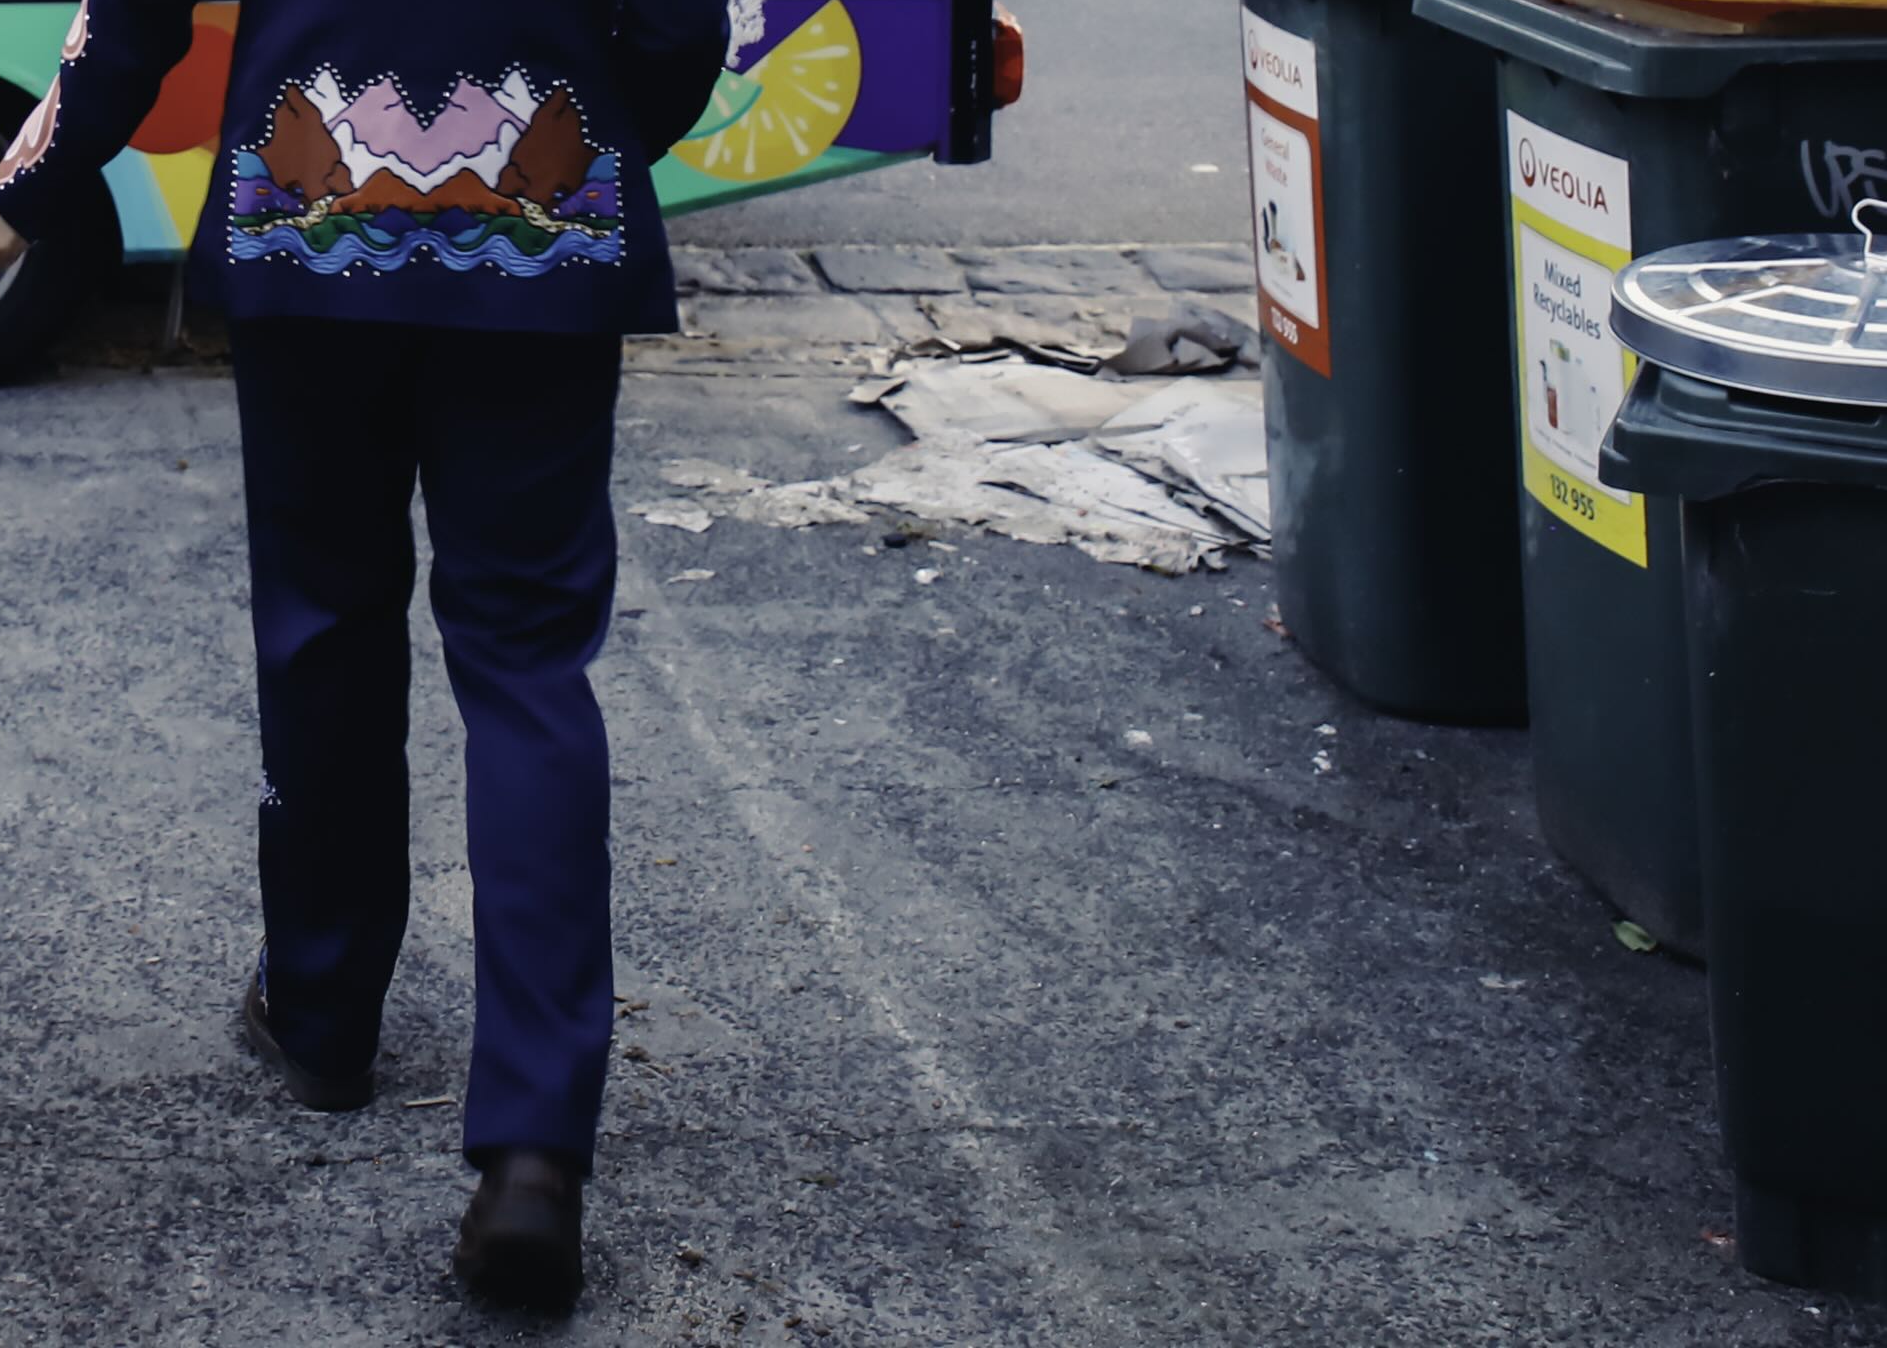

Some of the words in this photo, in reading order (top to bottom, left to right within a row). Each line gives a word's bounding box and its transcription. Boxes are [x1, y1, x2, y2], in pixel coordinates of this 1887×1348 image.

[1258, 50, 1303, 90] VEOLIA
[1539, 160, 1609, 215] VEOLIA
[1544, 258, 1582, 300] Mixed
[1533, 283, 1602, 342] Recyclables
[1550, 473, 1569, 505] 132
[1570, 490, 1596, 522] 955
